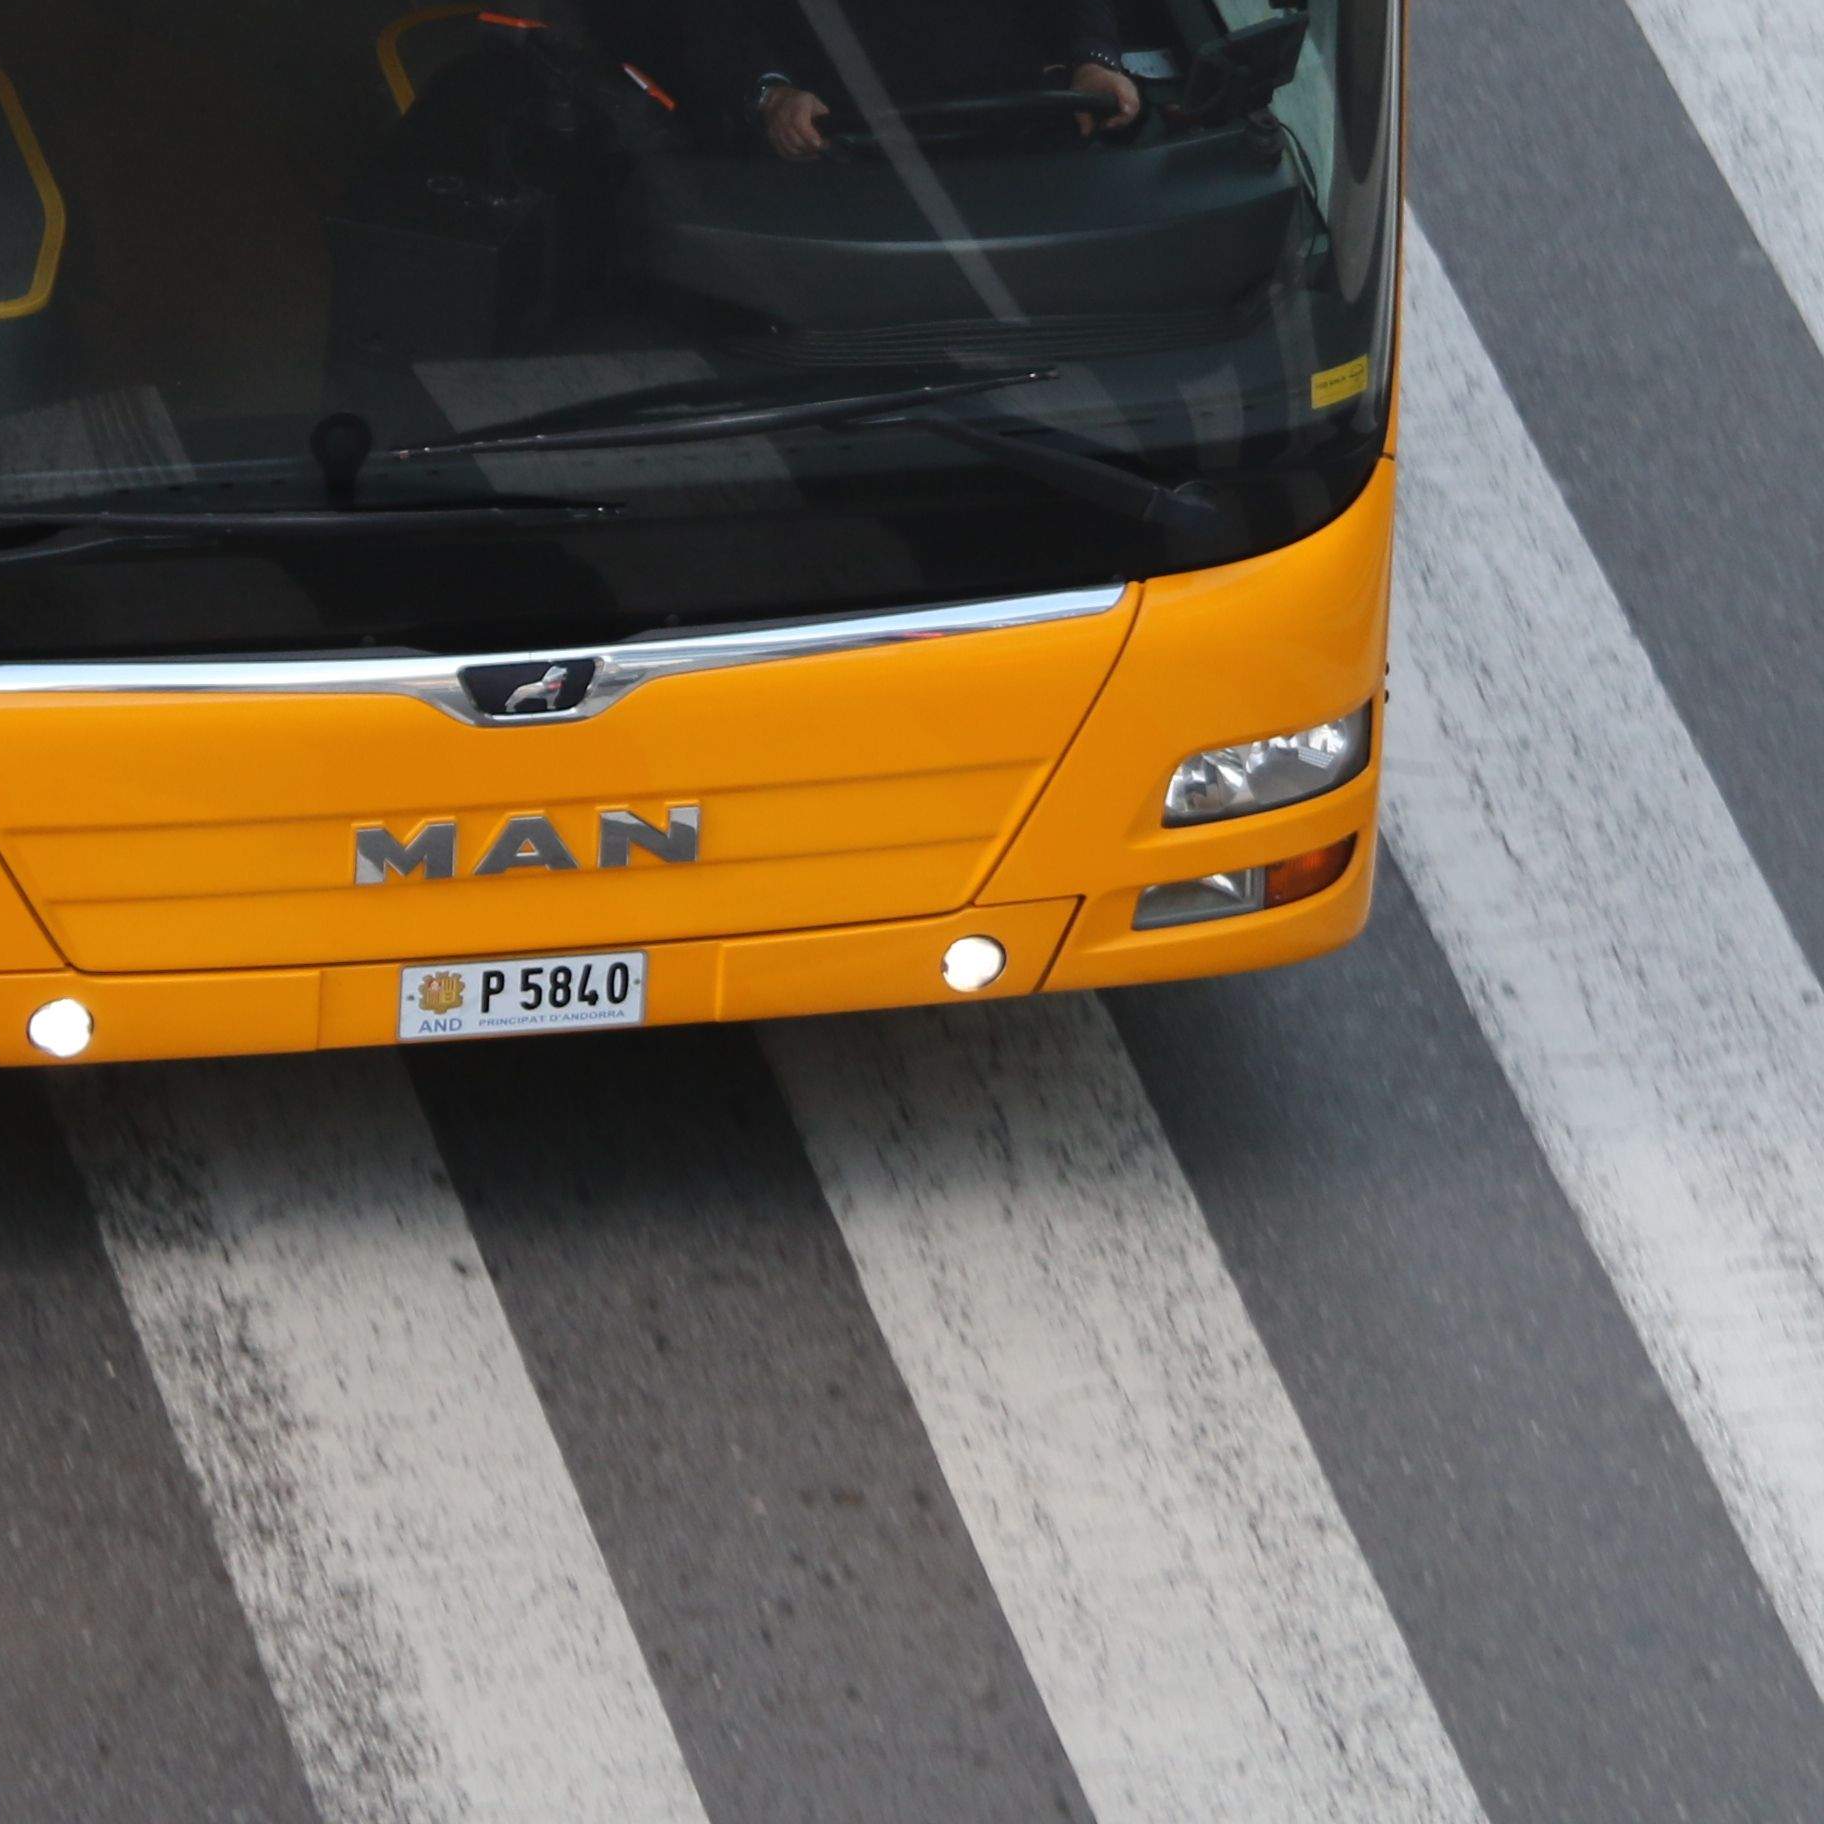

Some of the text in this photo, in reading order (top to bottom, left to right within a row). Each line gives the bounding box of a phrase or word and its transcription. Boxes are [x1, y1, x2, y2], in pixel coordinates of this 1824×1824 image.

[353, 804, 701, 886] MAN
[480, 961, 630, 1014] P 5840
[417, 1017, 463, 1034] AND
[478, 1009, 625, 1027] PRINCIPAT D'ANDORRA
